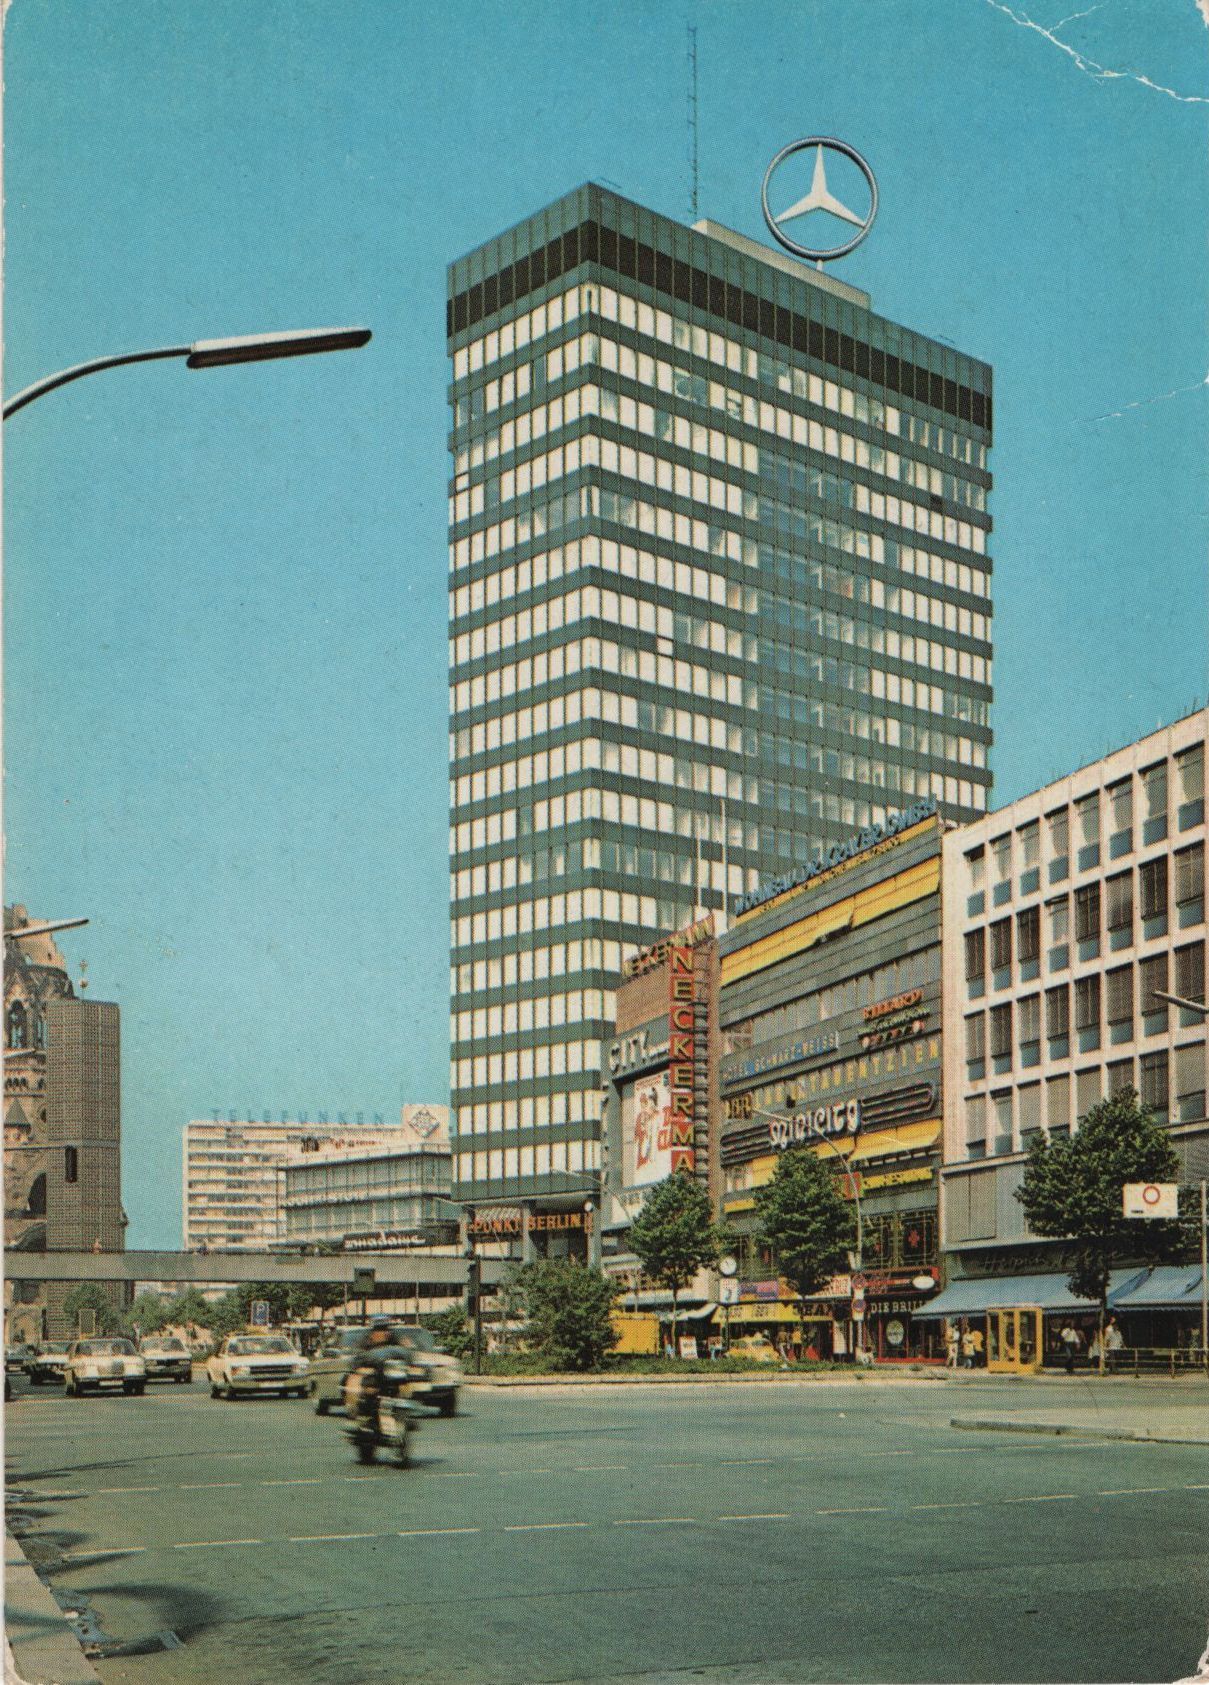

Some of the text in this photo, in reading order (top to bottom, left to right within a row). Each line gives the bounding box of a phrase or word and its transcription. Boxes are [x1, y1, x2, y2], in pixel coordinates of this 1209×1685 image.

[609, 1032, 649, 1072] CITY
[671, 951, 694, 1172] NECKERMA
[210, 1109, 385, 1125] TELEFUNKEN
[528, 1212, 581, 1231] BERLIN
[870, 1299, 925, 1313] DIE BRILL
